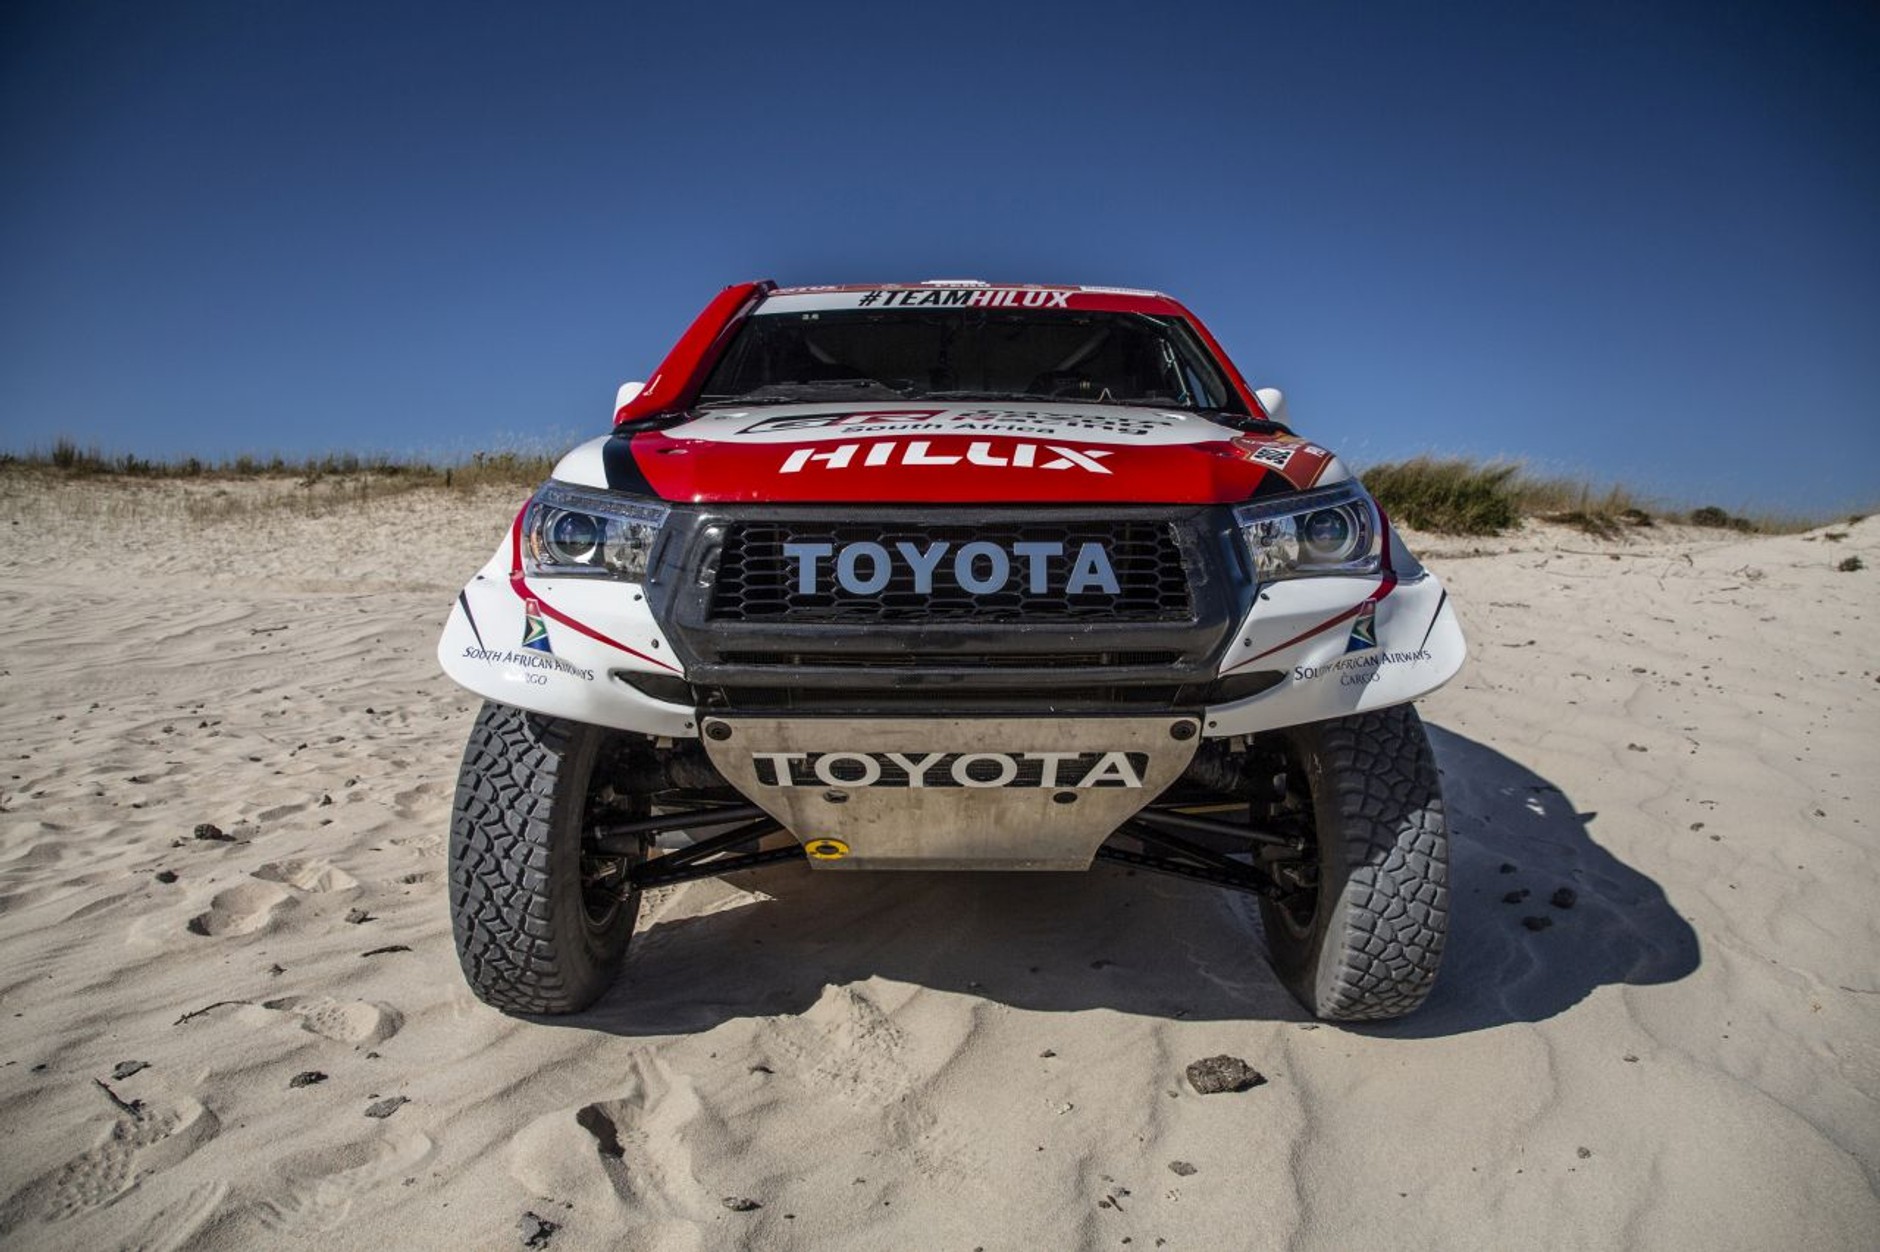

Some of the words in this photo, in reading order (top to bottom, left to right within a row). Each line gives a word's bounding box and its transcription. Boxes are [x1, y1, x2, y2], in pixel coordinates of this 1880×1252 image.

[858, 290, 1072, 308] #TEAMHILUX
[841, 423, 943, 433] South
[953, 422, 1055, 434] Africa
[779, 441, 1114, 474] HILUX
[783, 541, 1121, 594] TOYOTA
[463, 646, 502, 661] SOUTH
[503, 651, 553, 669] AFRICAN
[752, 752, 1143, 788] TOYOTA
